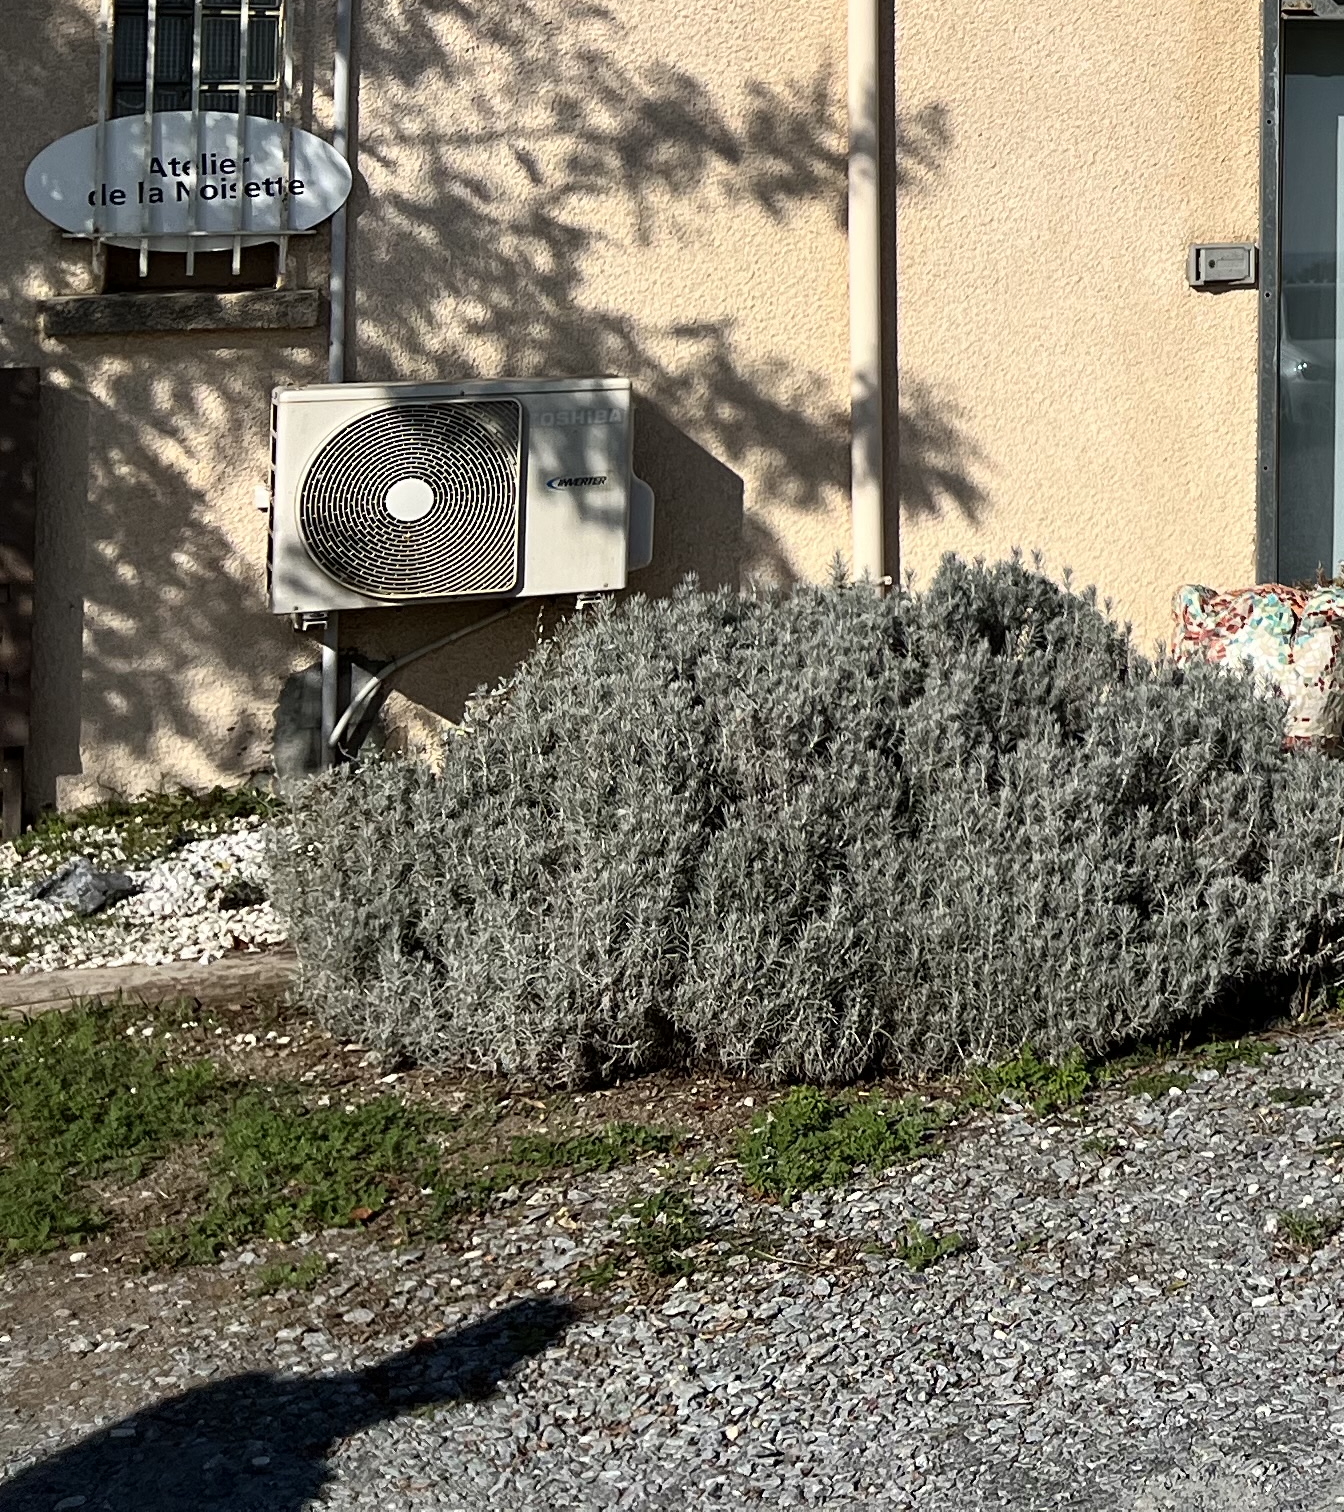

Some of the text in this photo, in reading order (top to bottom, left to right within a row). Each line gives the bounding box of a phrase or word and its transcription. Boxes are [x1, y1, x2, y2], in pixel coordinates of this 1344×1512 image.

[138, 181, 163, 203] la
[530, 407, 623, 427] TOSHIBA
[557, 476, 607, 487] INVERTER
